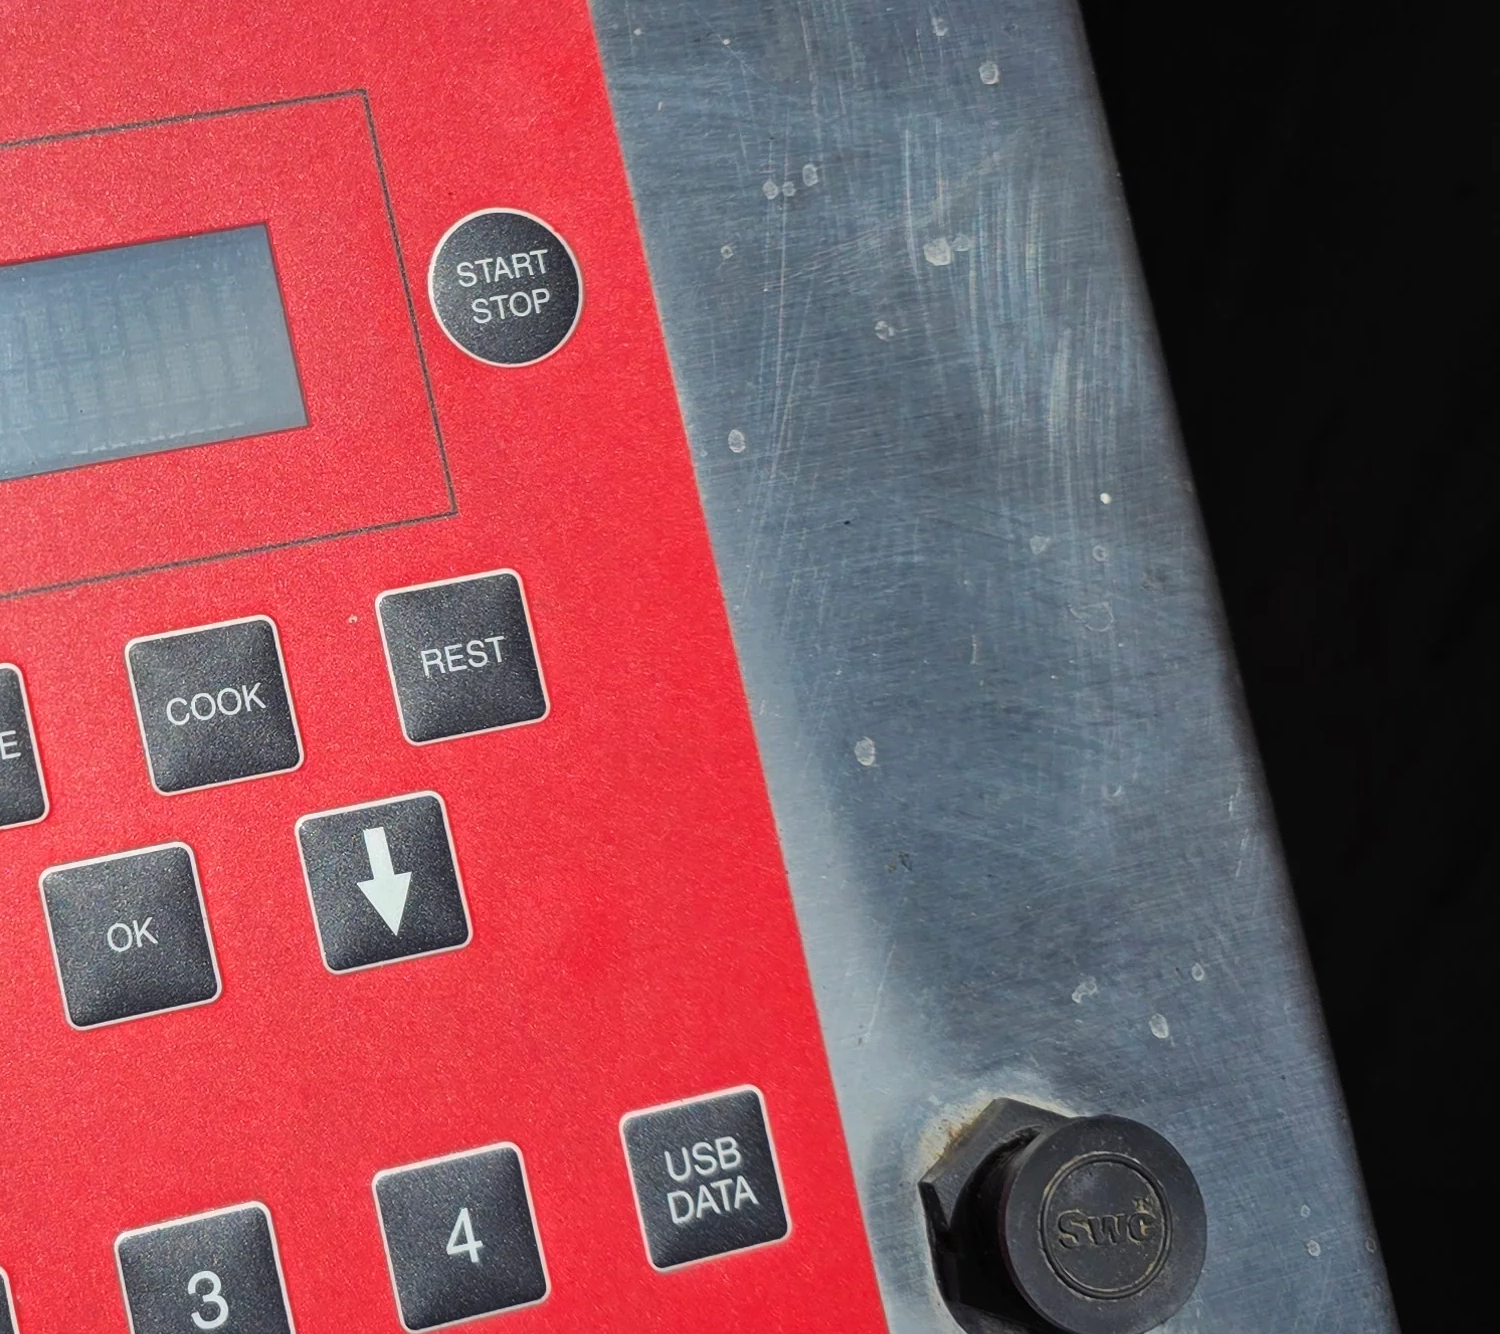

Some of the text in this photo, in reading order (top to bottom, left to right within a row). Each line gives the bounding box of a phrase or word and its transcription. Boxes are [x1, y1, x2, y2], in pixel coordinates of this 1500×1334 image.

[457, 250, 547, 287] START
[471, 289, 550, 324] STOP
[420, 636, 505, 677] REST
[166, 683, 267, 726] COOK
[107, 917, 158, 952] OK
[664, 1136, 742, 1182] USB
[666, 1176, 759, 1225] DATA
[446, 1208, 483, 1262] 4
[188, 1271, 228, 1329] 3
